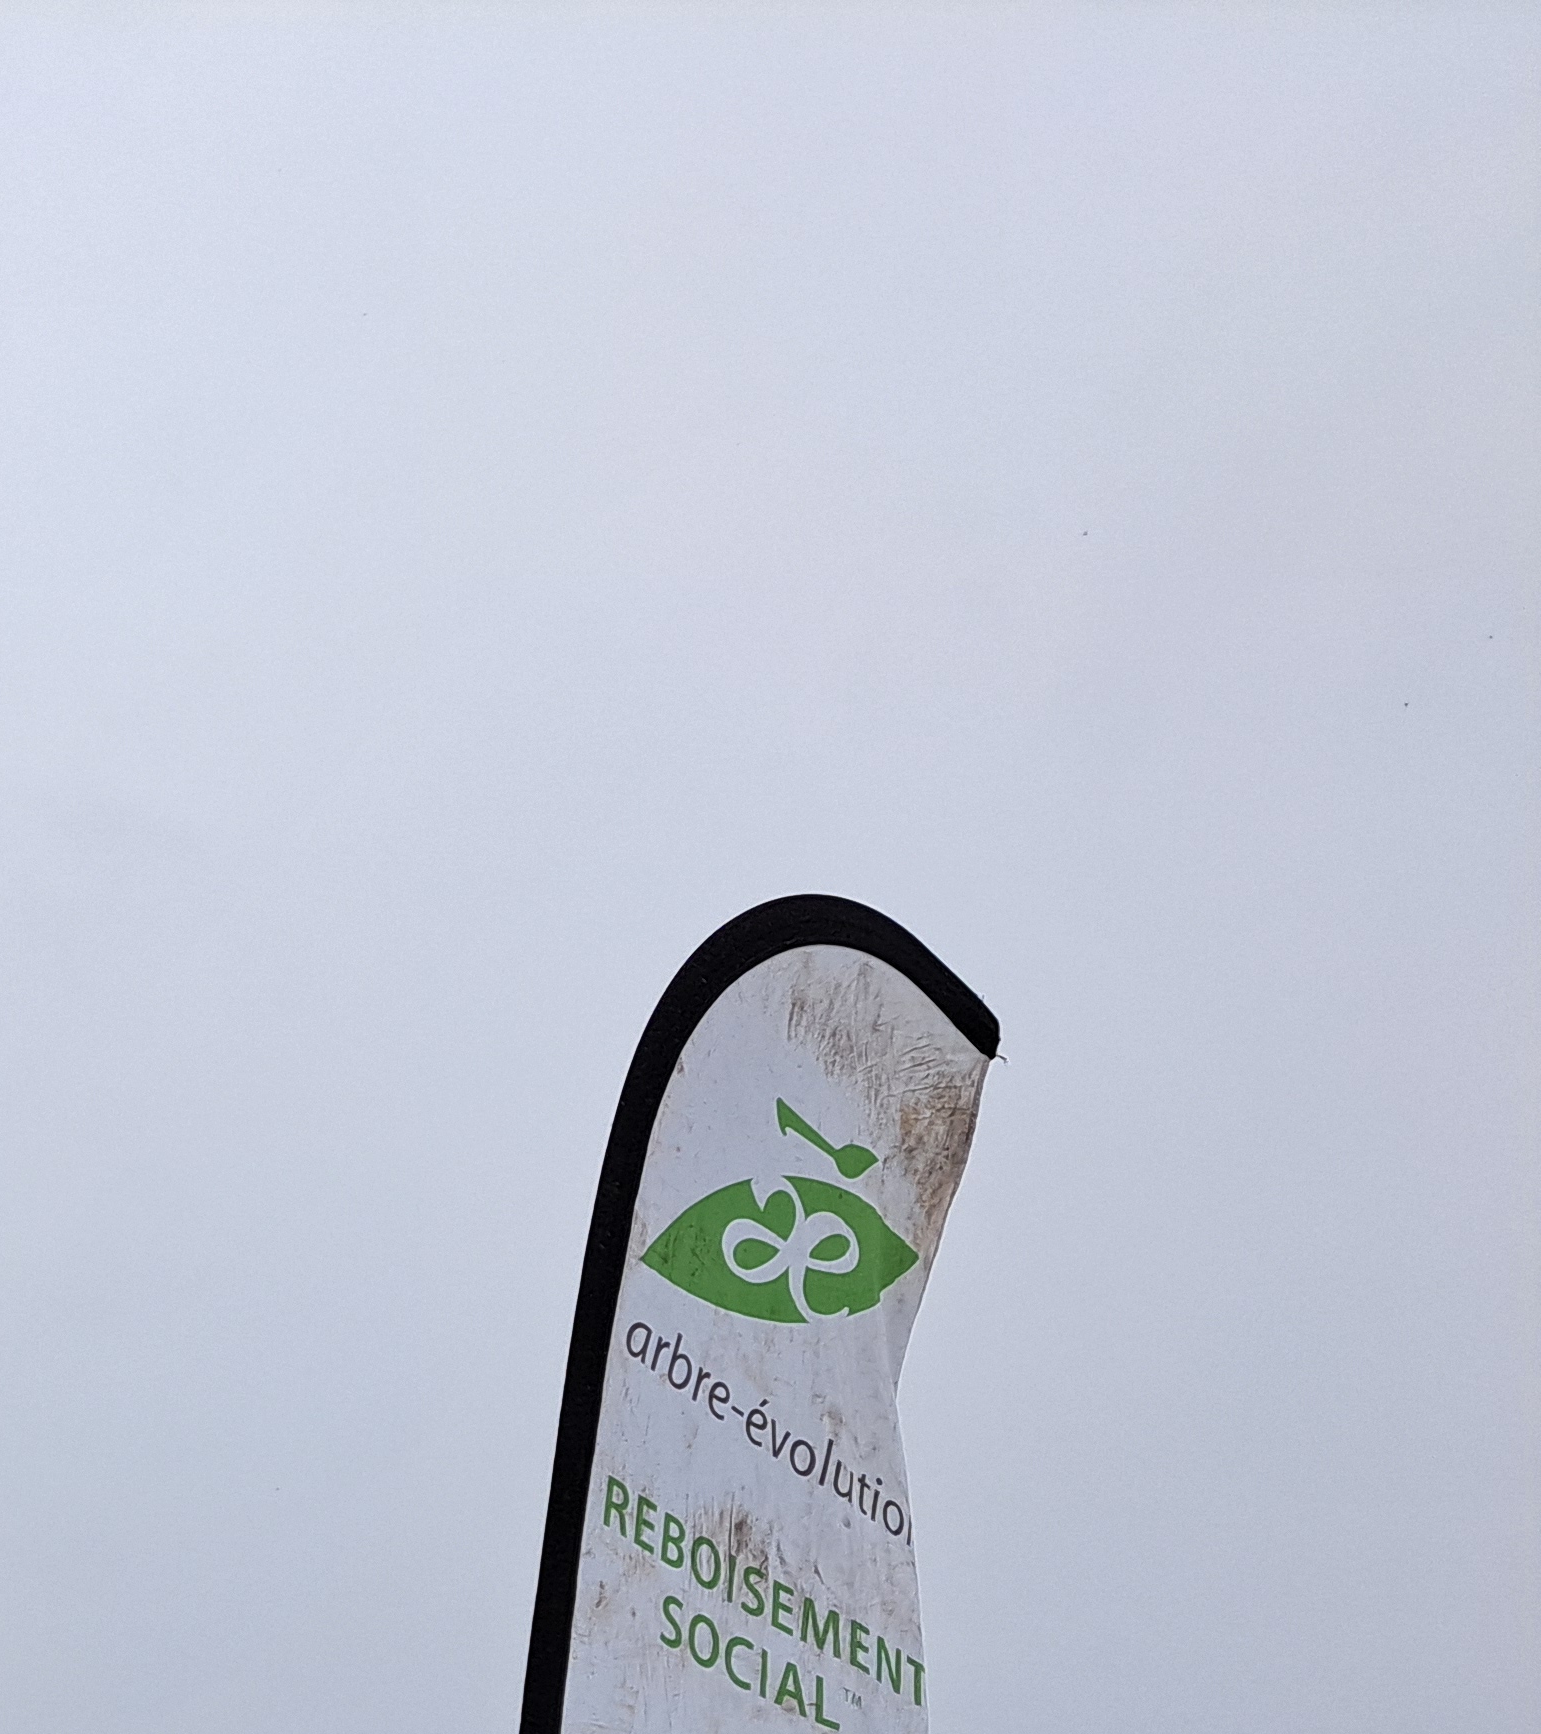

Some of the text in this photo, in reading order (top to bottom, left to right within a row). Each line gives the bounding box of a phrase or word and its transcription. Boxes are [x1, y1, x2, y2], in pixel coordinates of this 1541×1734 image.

[625, 1319, 913, 1546] arbre-évolutio
[602, 1475, 926, 1707] REBOISEMENT
[658, 1594, 841, 1732] SOCIAL
